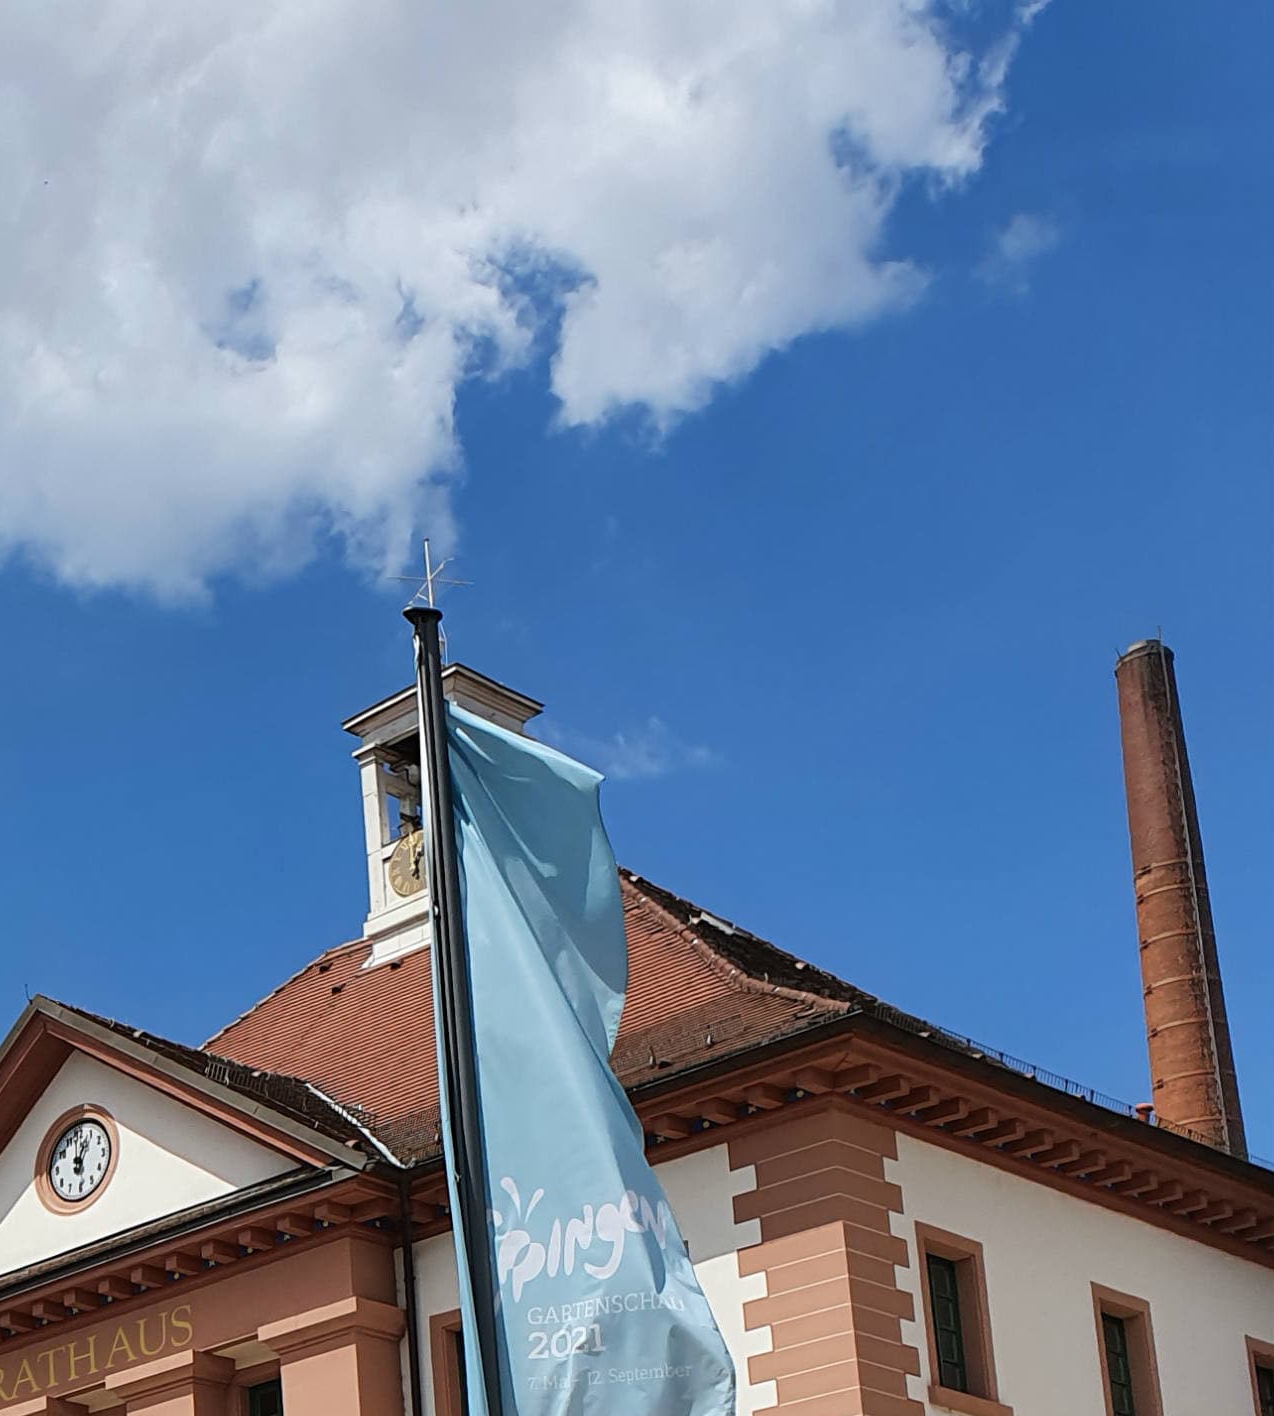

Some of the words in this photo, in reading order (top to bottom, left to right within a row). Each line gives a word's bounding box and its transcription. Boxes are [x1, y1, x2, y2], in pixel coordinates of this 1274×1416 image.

[526, 1292, 685, 1326] GARTENSCHAU
[527, 1322, 606, 1360] 2021
[607, 1364, 693, 1385] September
